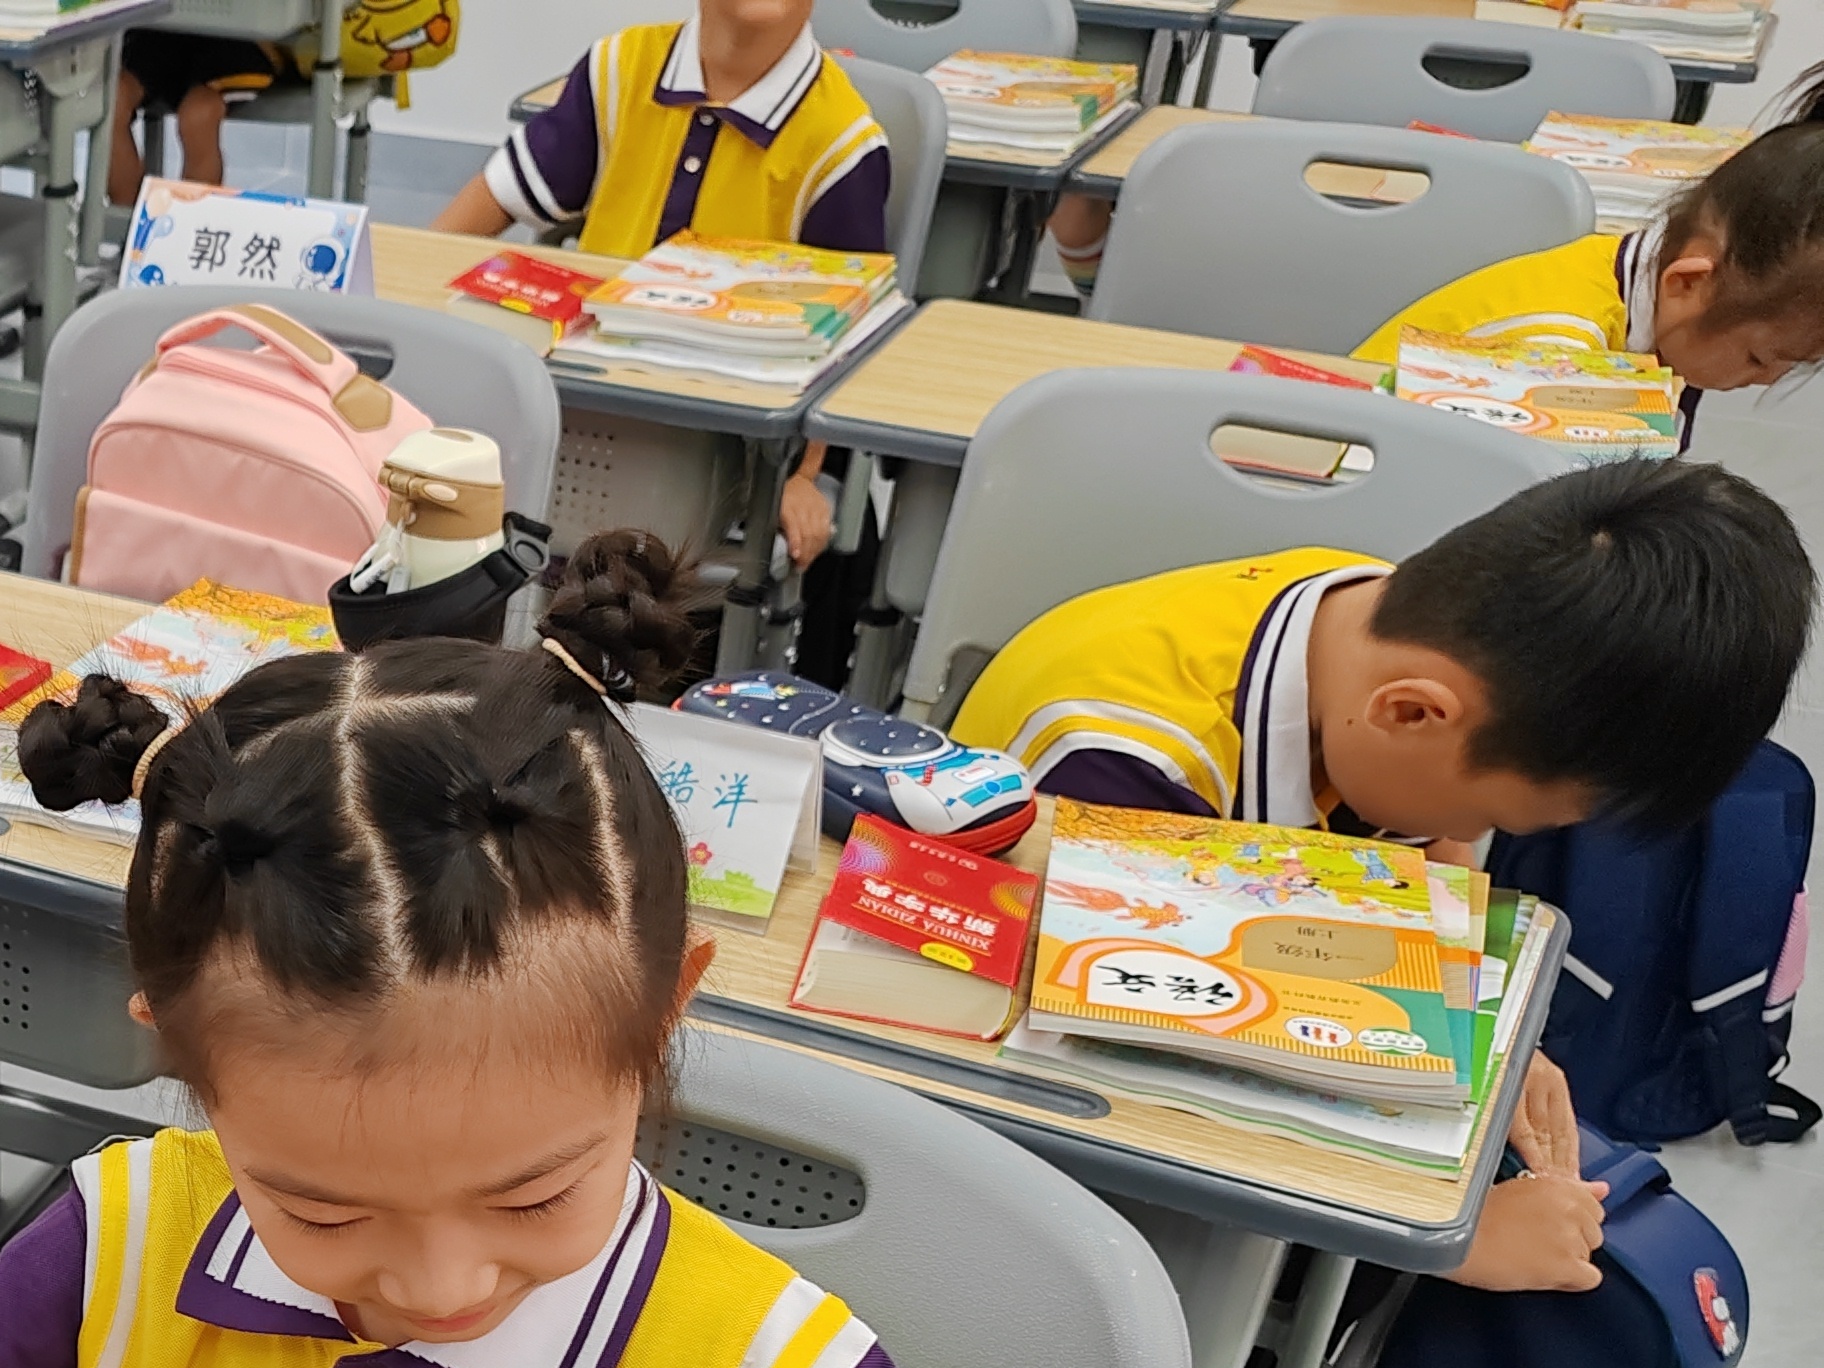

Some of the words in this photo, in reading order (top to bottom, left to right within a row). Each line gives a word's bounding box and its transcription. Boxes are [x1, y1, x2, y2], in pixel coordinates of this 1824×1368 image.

[188, 226, 282, 281] 郭然
[861, 878, 997, 937] 新华字典
[1096, 965, 1234, 1006] 语文
